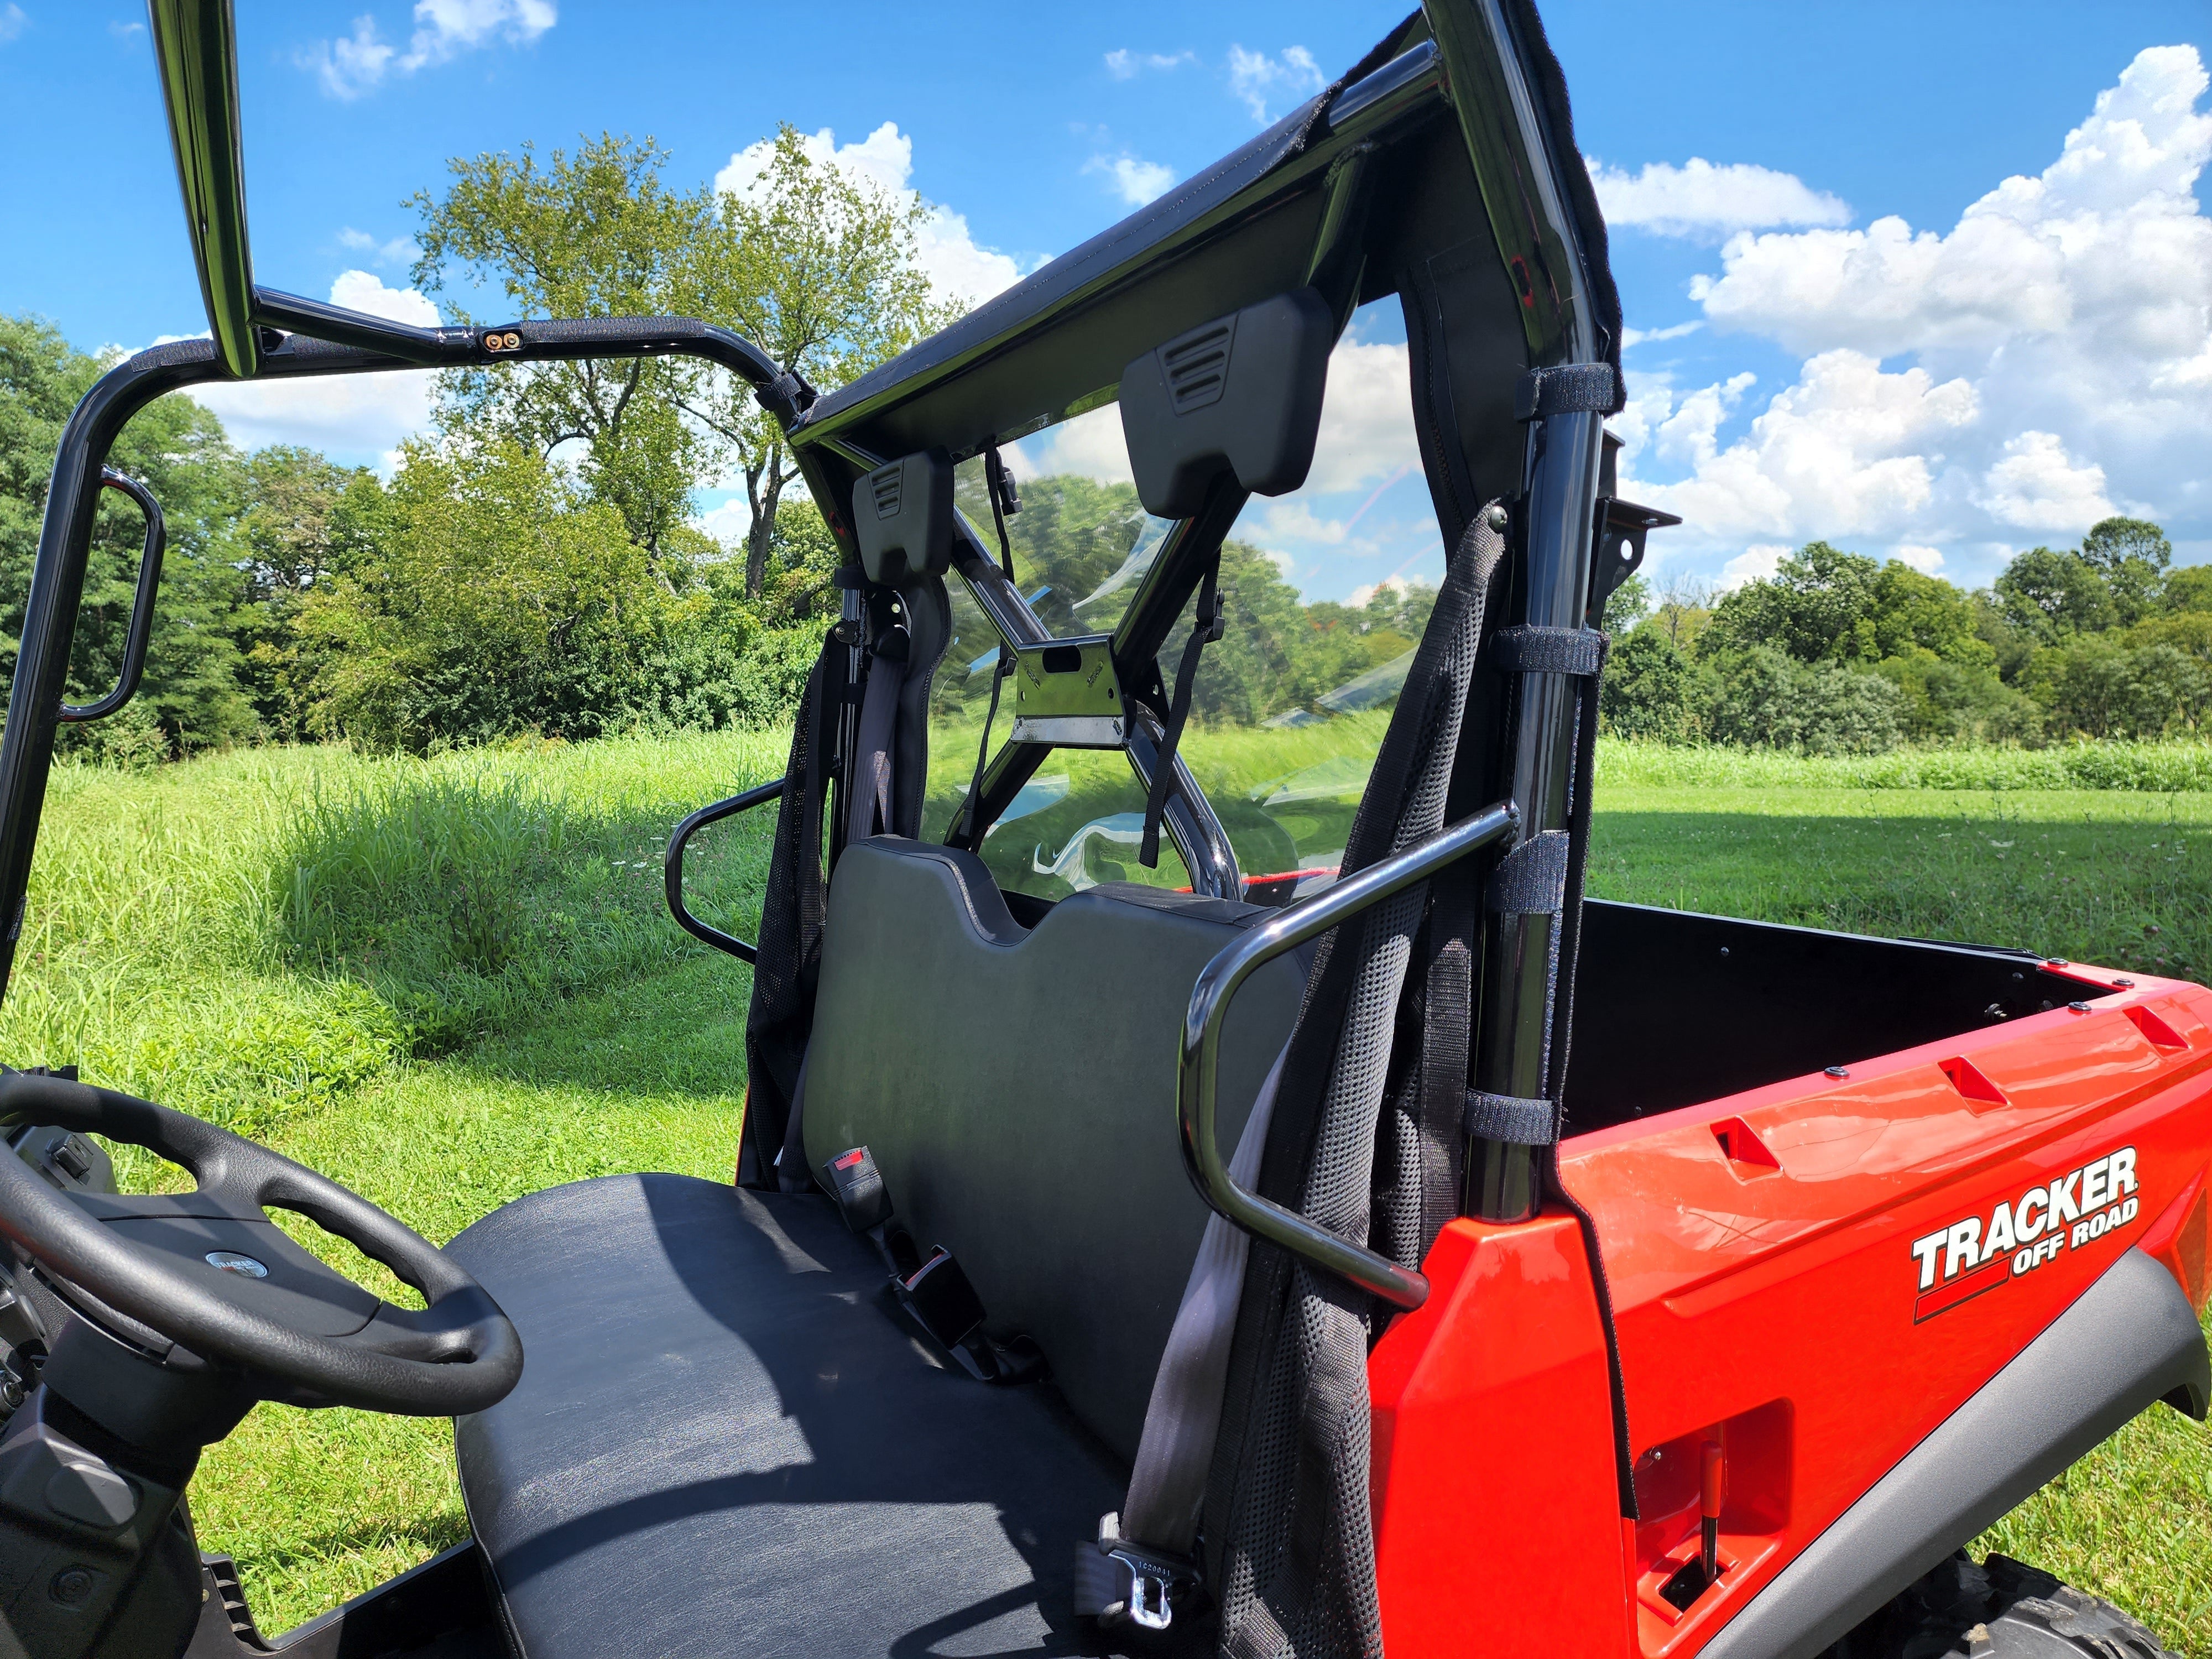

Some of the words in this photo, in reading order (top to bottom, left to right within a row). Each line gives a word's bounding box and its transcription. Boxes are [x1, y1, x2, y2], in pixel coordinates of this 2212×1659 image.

[1912, 1146, 2137, 1290] TRACKER
[2013, 1233, 2065, 1275] OFF
[2070, 1197, 2138, 1251] ROAD
